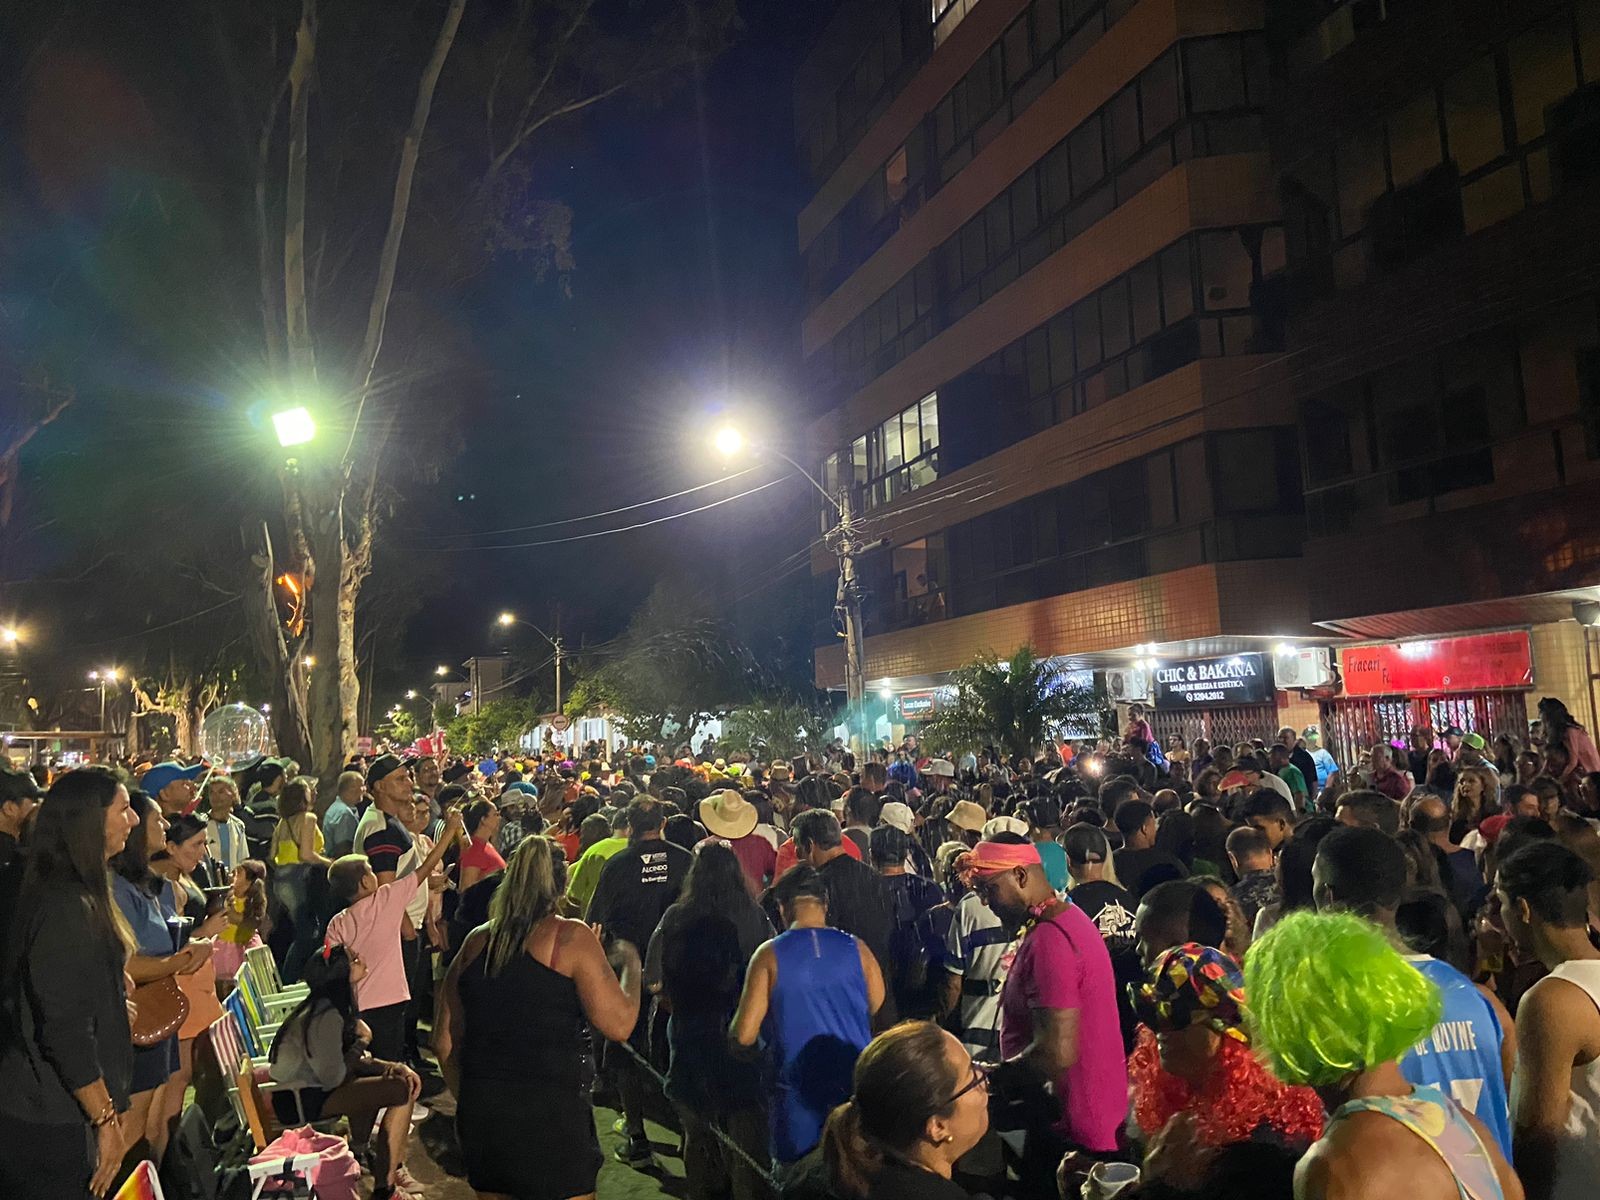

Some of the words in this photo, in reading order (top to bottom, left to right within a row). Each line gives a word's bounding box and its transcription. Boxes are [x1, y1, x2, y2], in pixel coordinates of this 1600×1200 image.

[1156, 667, 1185, 683] CHIC
[1187, 666, 1198, 681] &
[1199, 661, 1256, 680] BAKANA
[1194, 682, 1214, 690] BELEZA
